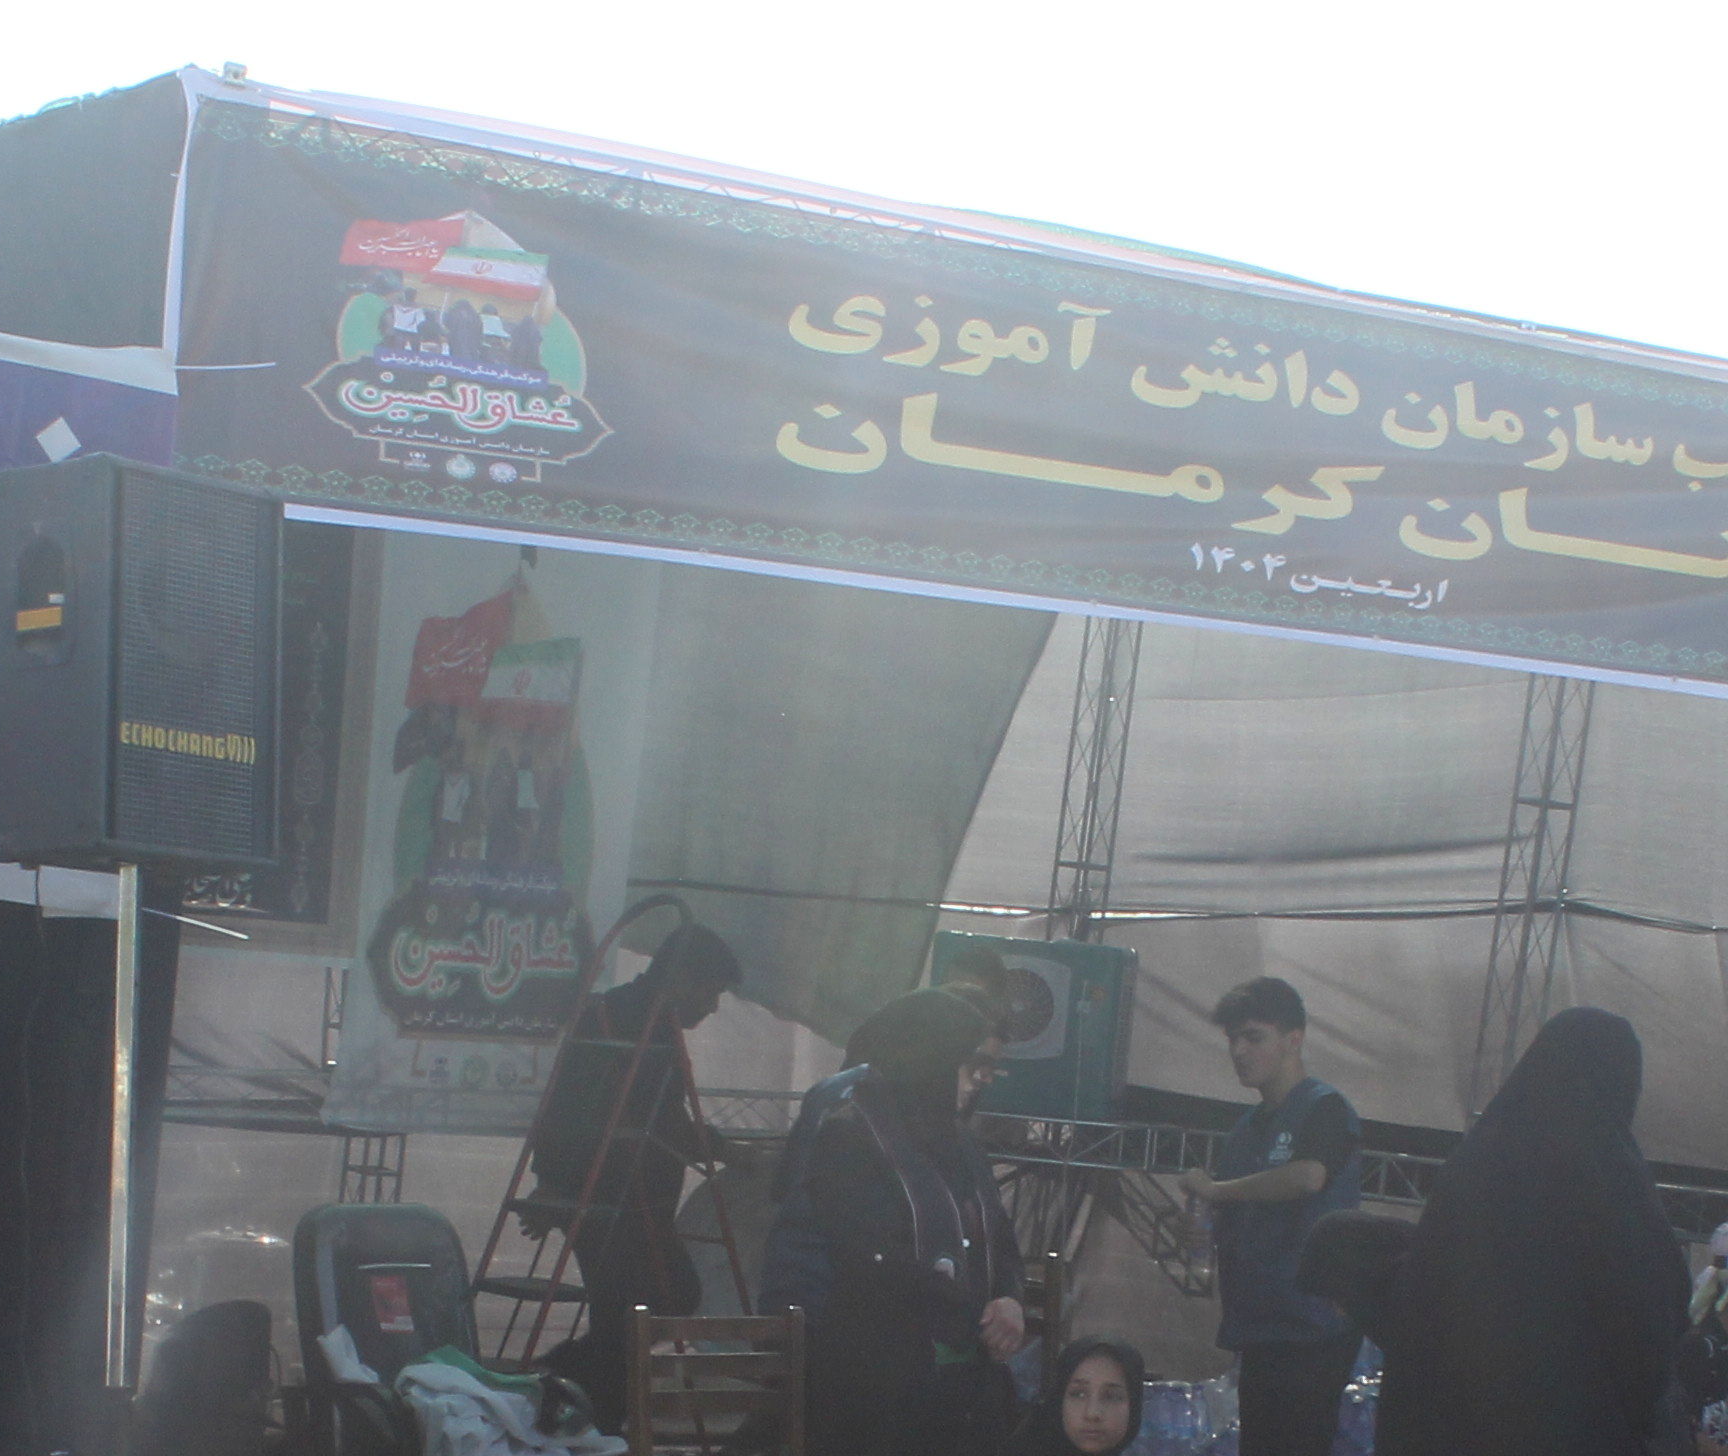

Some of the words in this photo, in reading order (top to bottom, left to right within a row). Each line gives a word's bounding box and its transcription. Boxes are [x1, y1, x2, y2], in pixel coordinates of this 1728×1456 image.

[788, 294, 1112, 376] آموزی
[1130, 336, 1360, 416] دانش
[776, 392, 1386, 535] کرمان
[1381, 381, 1654, 472] سازمان
[1289, 574, 1450, 610] اربعین
